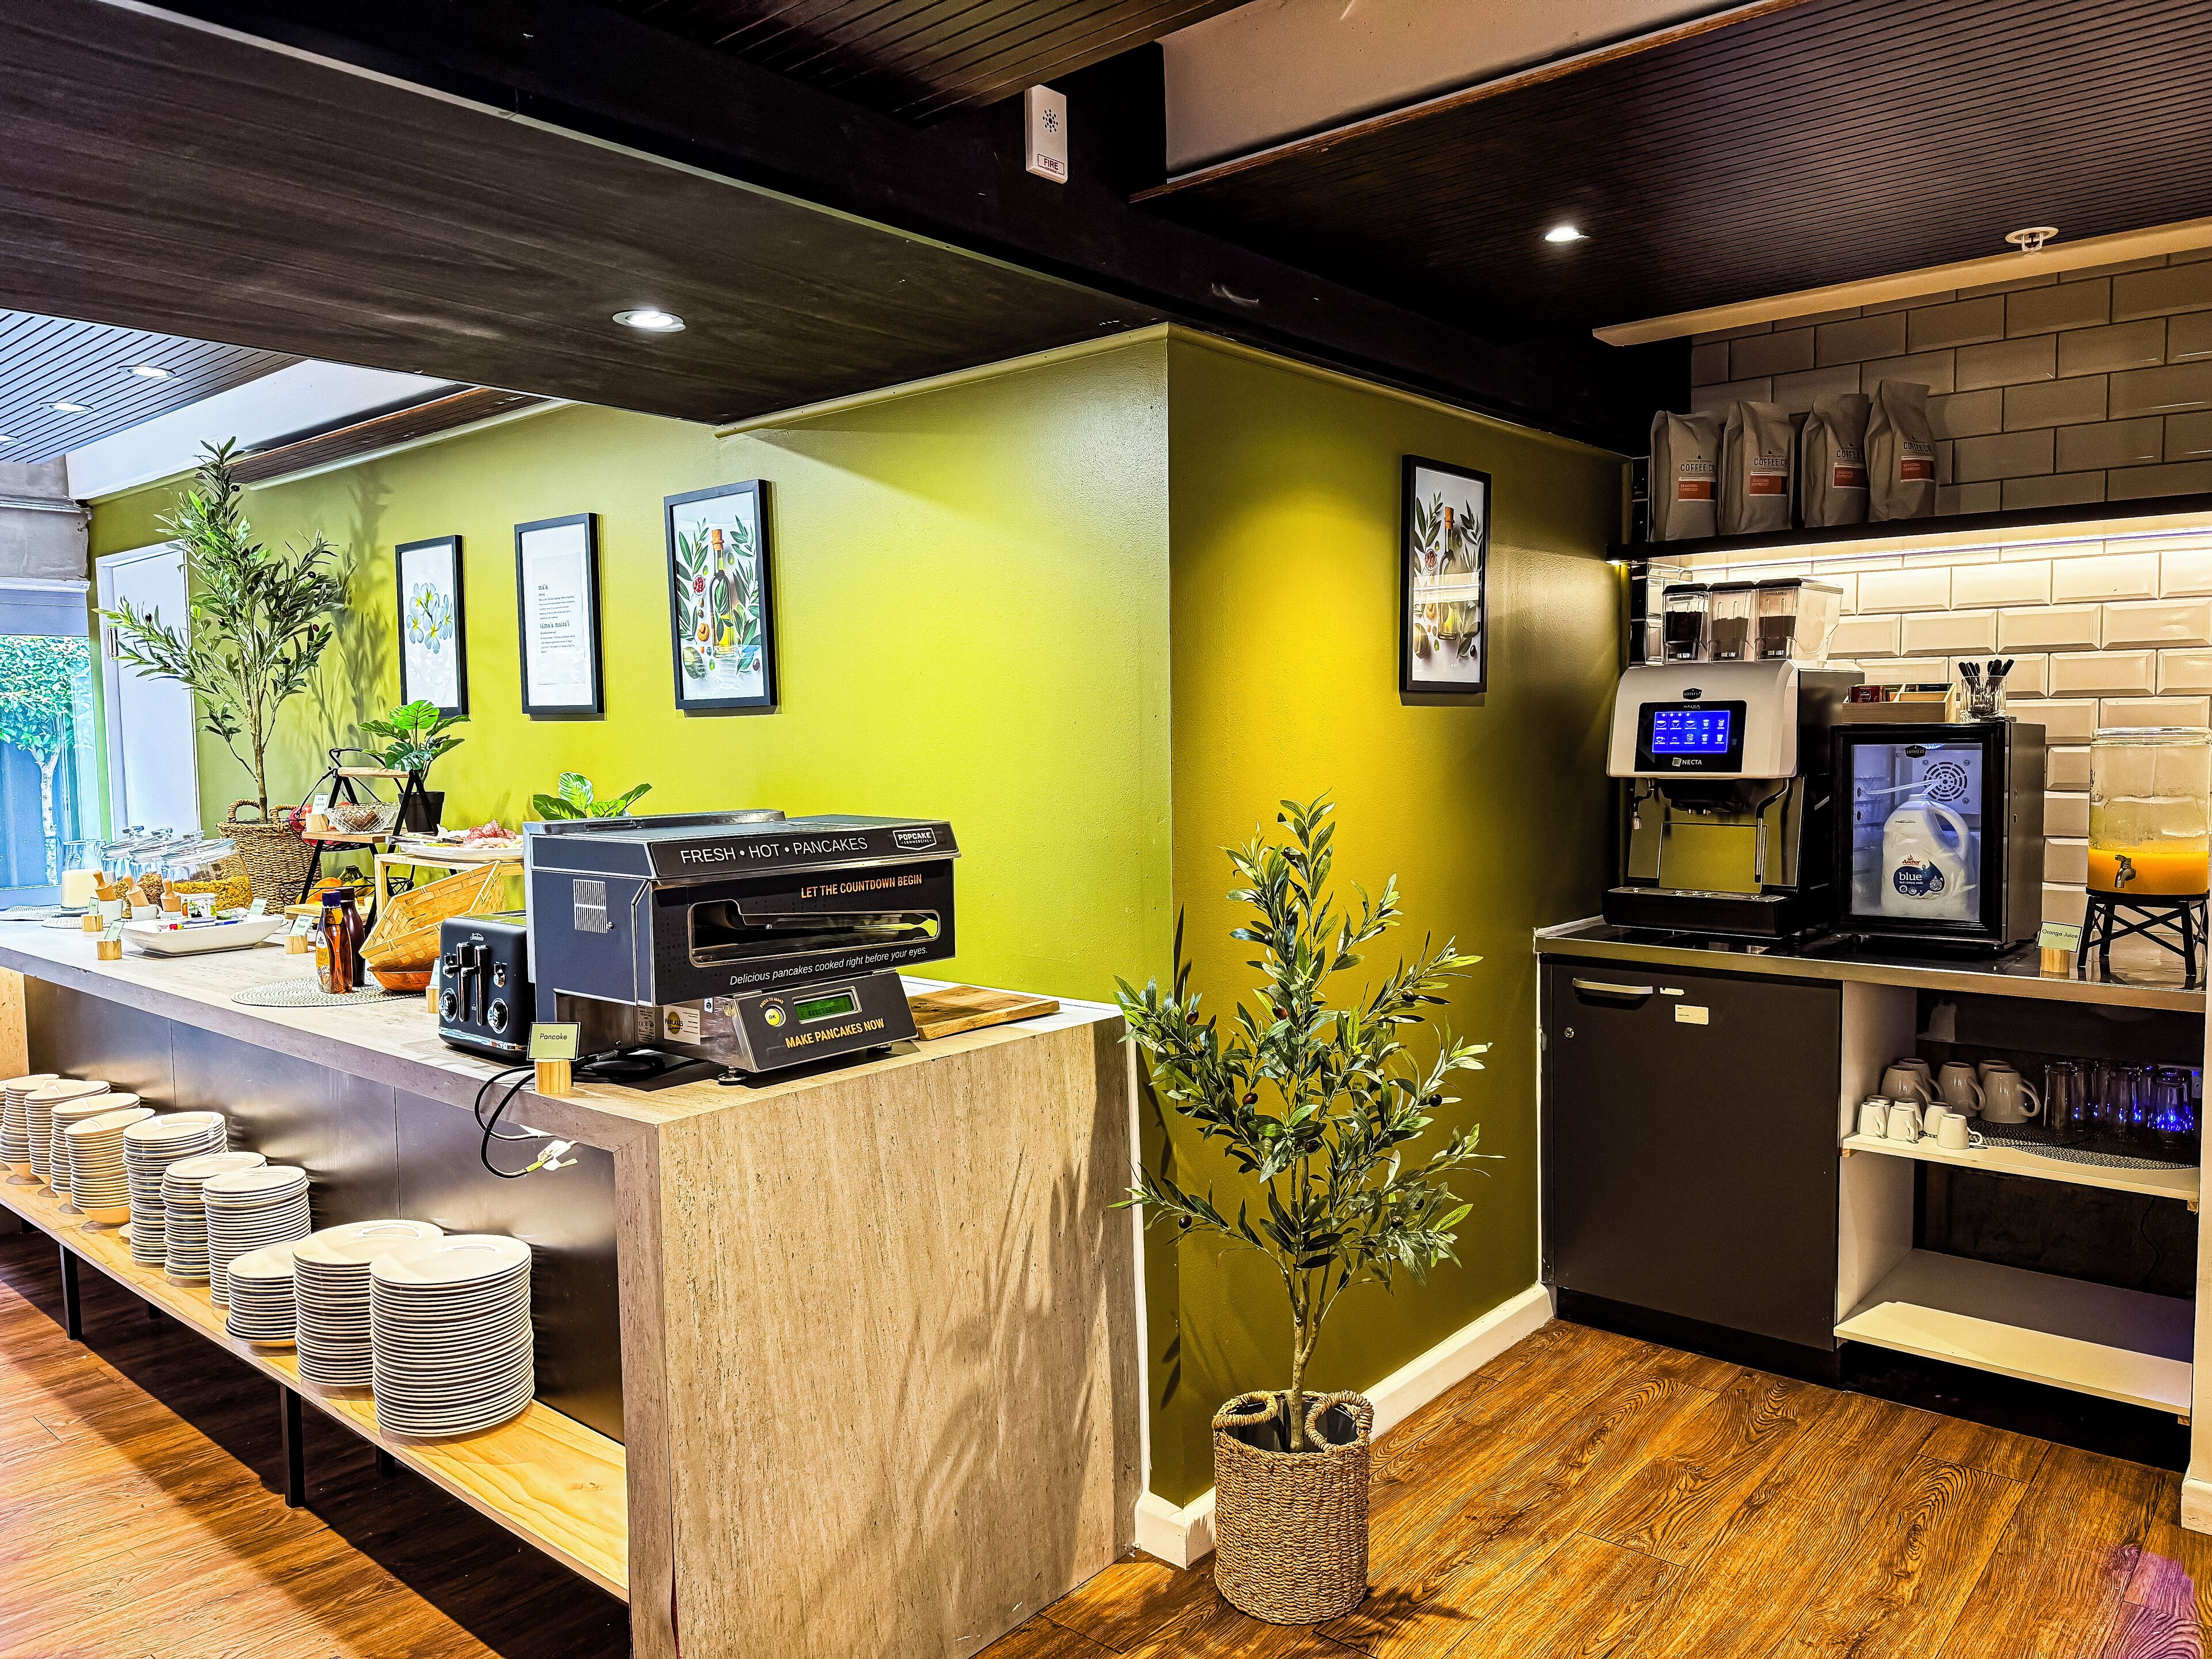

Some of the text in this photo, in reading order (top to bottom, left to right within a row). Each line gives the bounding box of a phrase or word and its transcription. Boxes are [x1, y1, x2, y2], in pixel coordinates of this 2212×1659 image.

[1044, 158, 1059, 170] FIRE
[1836, 450, 1859, 459] COFFEE
[1754, 458, 1779, 466] COFFEE
[897, 832, 931, 841] POPCAKE
[680, 837, 868, 863] FRESH HOT PANCAKES
[1899, 872, 1922, 881] blue
[801, 873, 922, 899] LET THE COUNTDOWN BEGIN
[2041, 929, 2063, 937] Orange
[730, 946, 928, 986] Delicious pancakes cooked right before your eyes.
[759, 998, 769, 1009] PRESS
[785, 1018, 885, 1048] MAKE PANCAKES NOW
